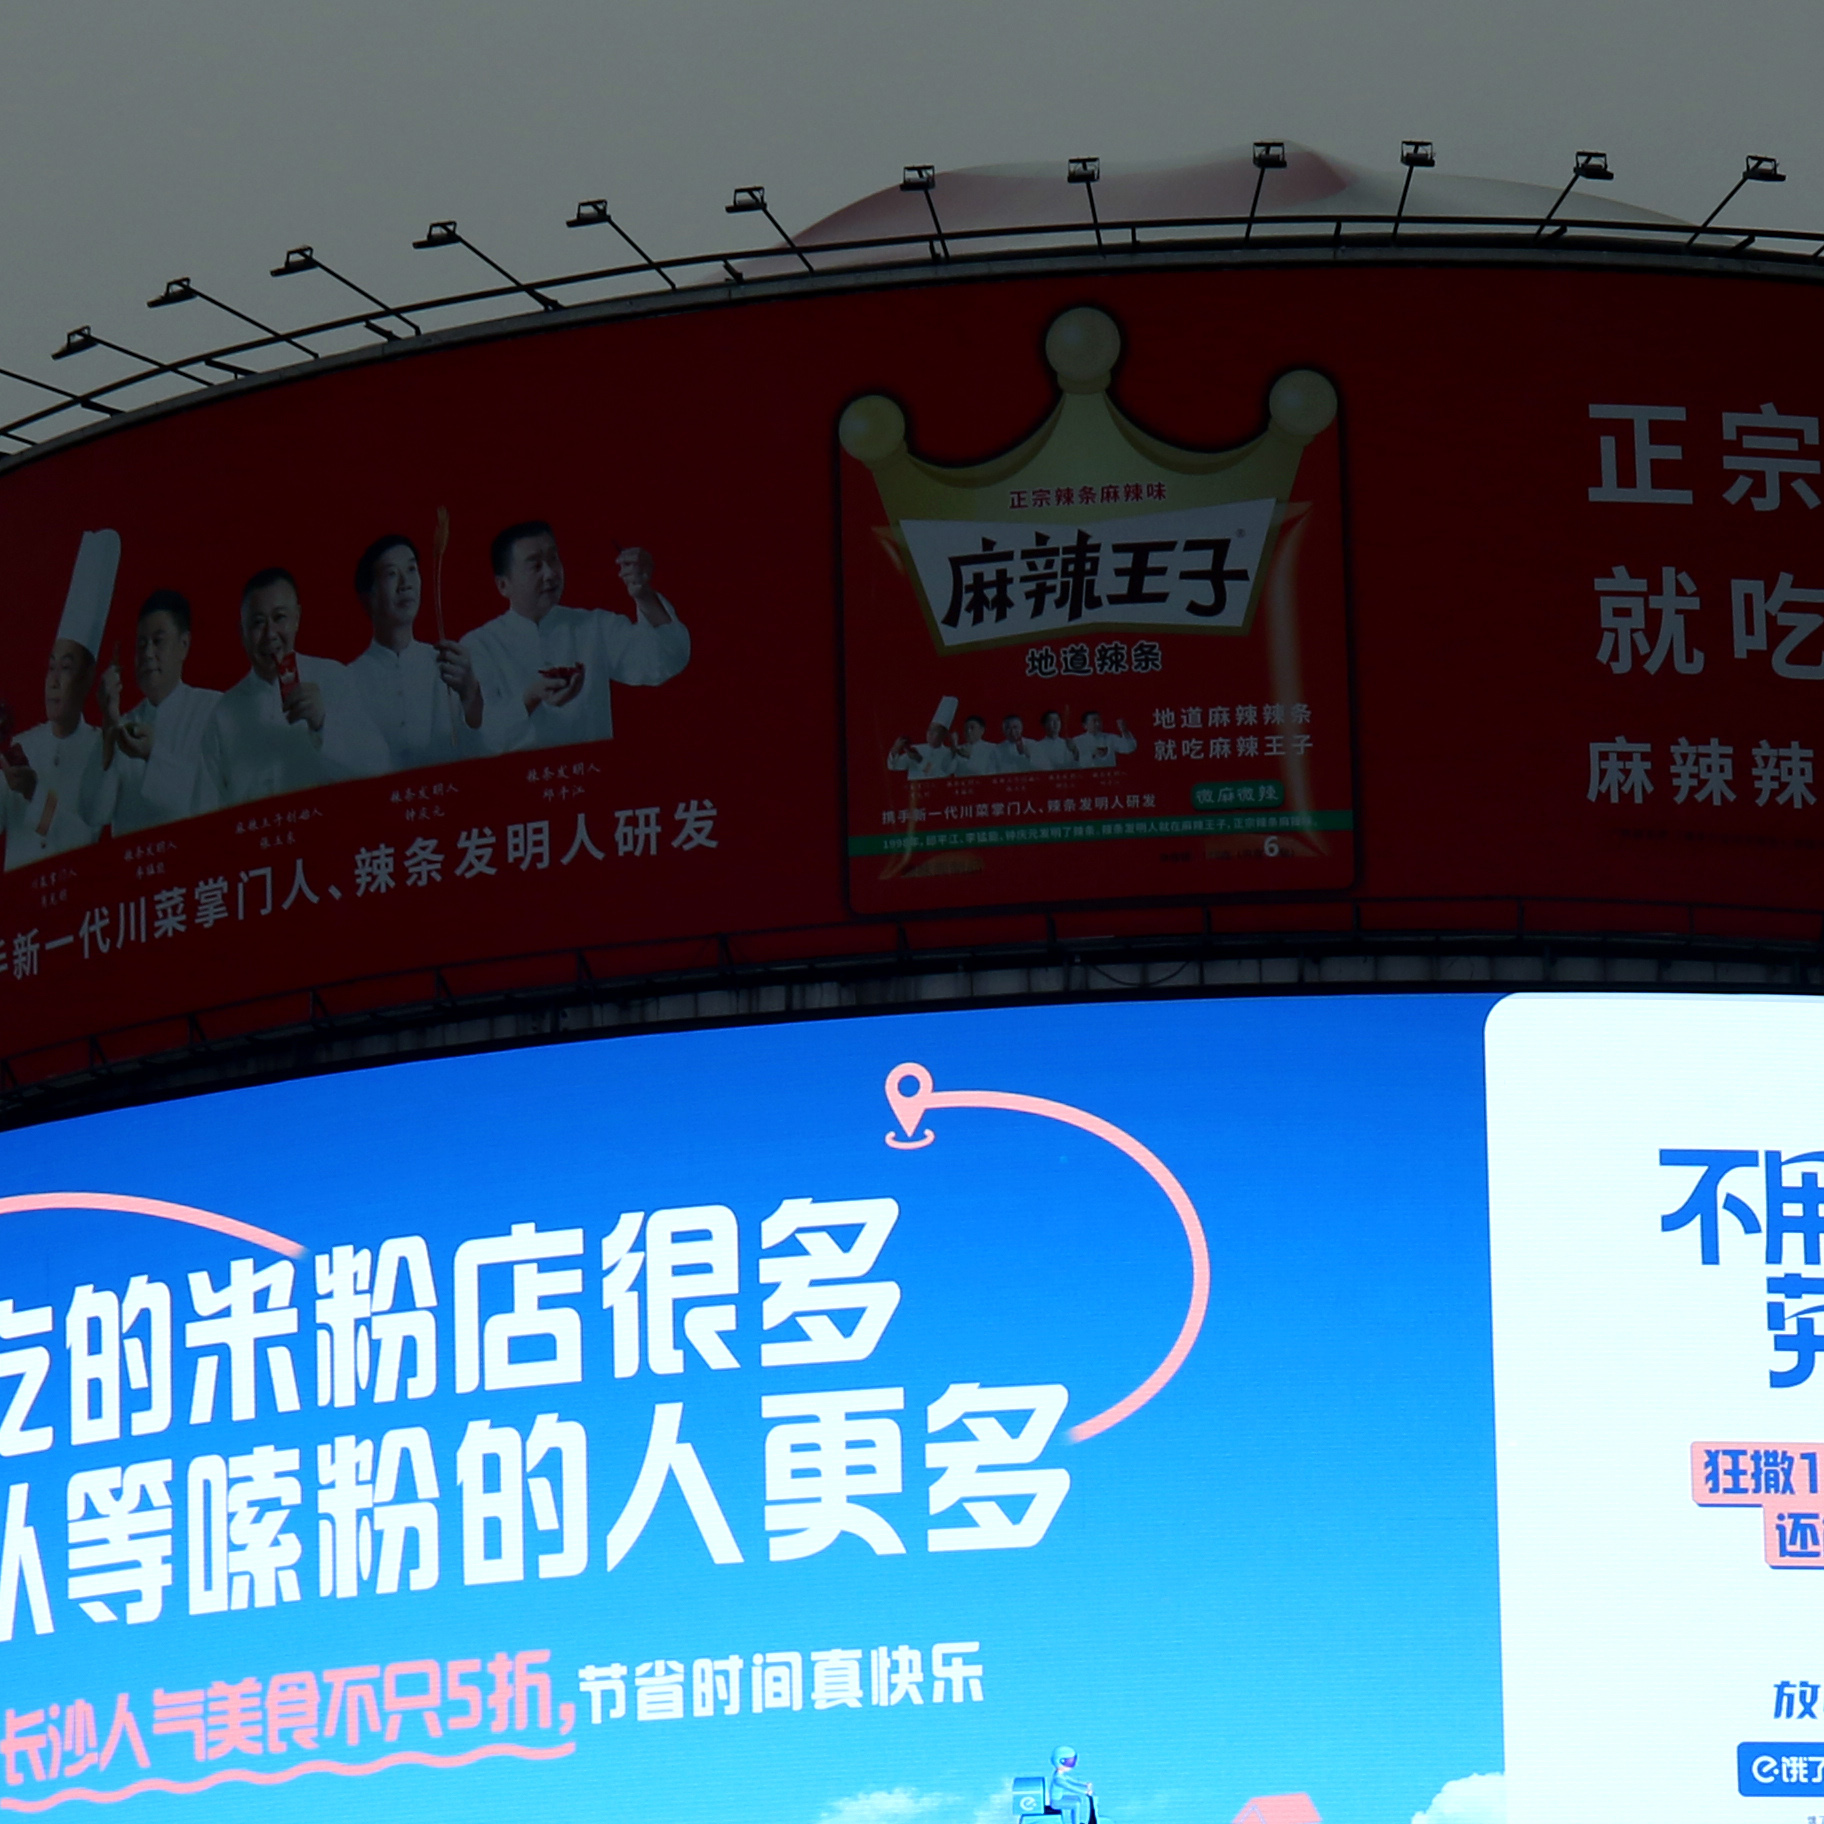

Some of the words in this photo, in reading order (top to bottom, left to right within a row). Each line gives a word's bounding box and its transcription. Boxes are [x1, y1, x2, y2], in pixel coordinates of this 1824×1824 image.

[1009, 482, 1166, 510] 正宗辣条麻辣味
[942, 530, 1249, 628] 麻辣王子
[1026, 641, 1163, 676] 地道辣条
[1152, 703, 1312, 729] 地道麻辣辣条
[1153, 733, 1314, 761] 就吃麻辣王子
